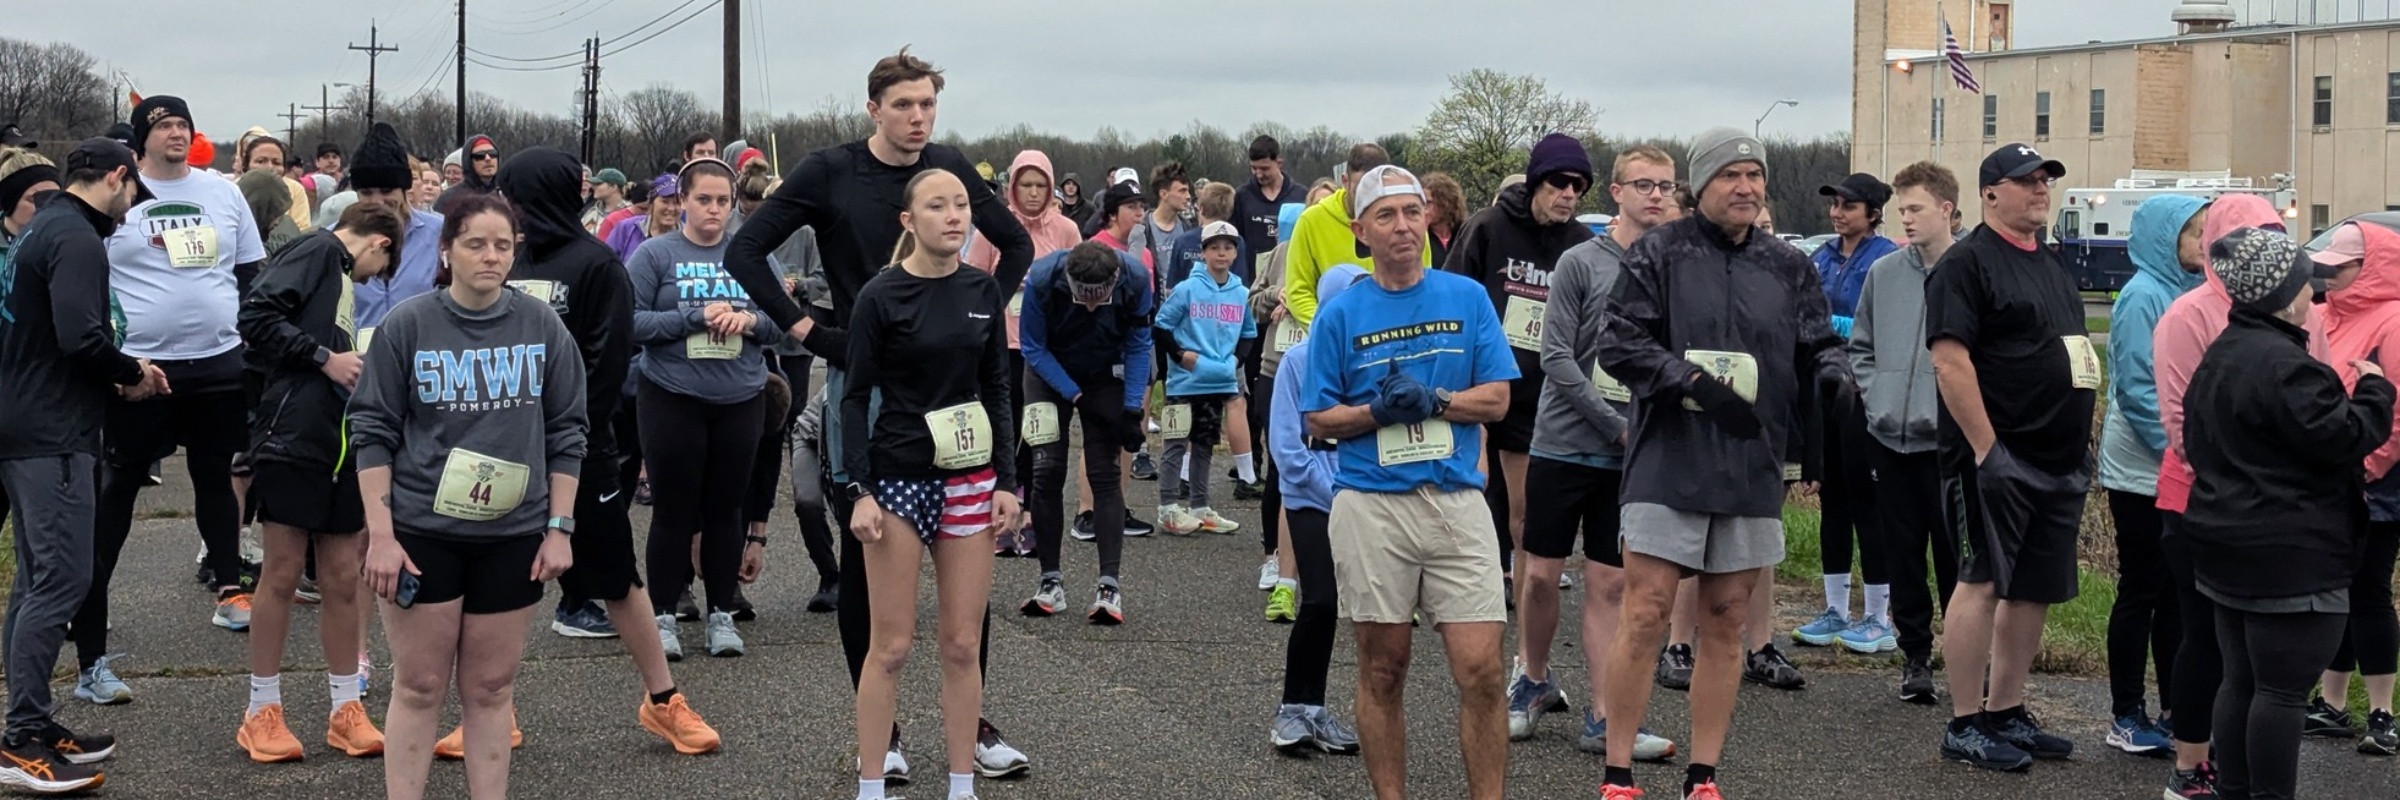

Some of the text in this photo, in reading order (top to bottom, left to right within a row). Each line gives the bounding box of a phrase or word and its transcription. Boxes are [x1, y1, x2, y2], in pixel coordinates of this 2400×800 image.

[185, 240, 204, 255] 176
[676, 279, 750, 300] TRAIL
[1288, 329, 1303, 344] 119
[1361, 322, 1458, 346] RUNNING WILD
[1525, 320, 1542, 338] 49
[414, 344, 546, 403] SMWC
[449, 399, 522, 412] POMEROY
[1030, 418, 1040, 435] 37
[1167, 417, 1178, 430] 41
[954, 427, 975, 452] 157
[1407, 423, 1425, 444] 19
[469, 481, 492, 505] 44
